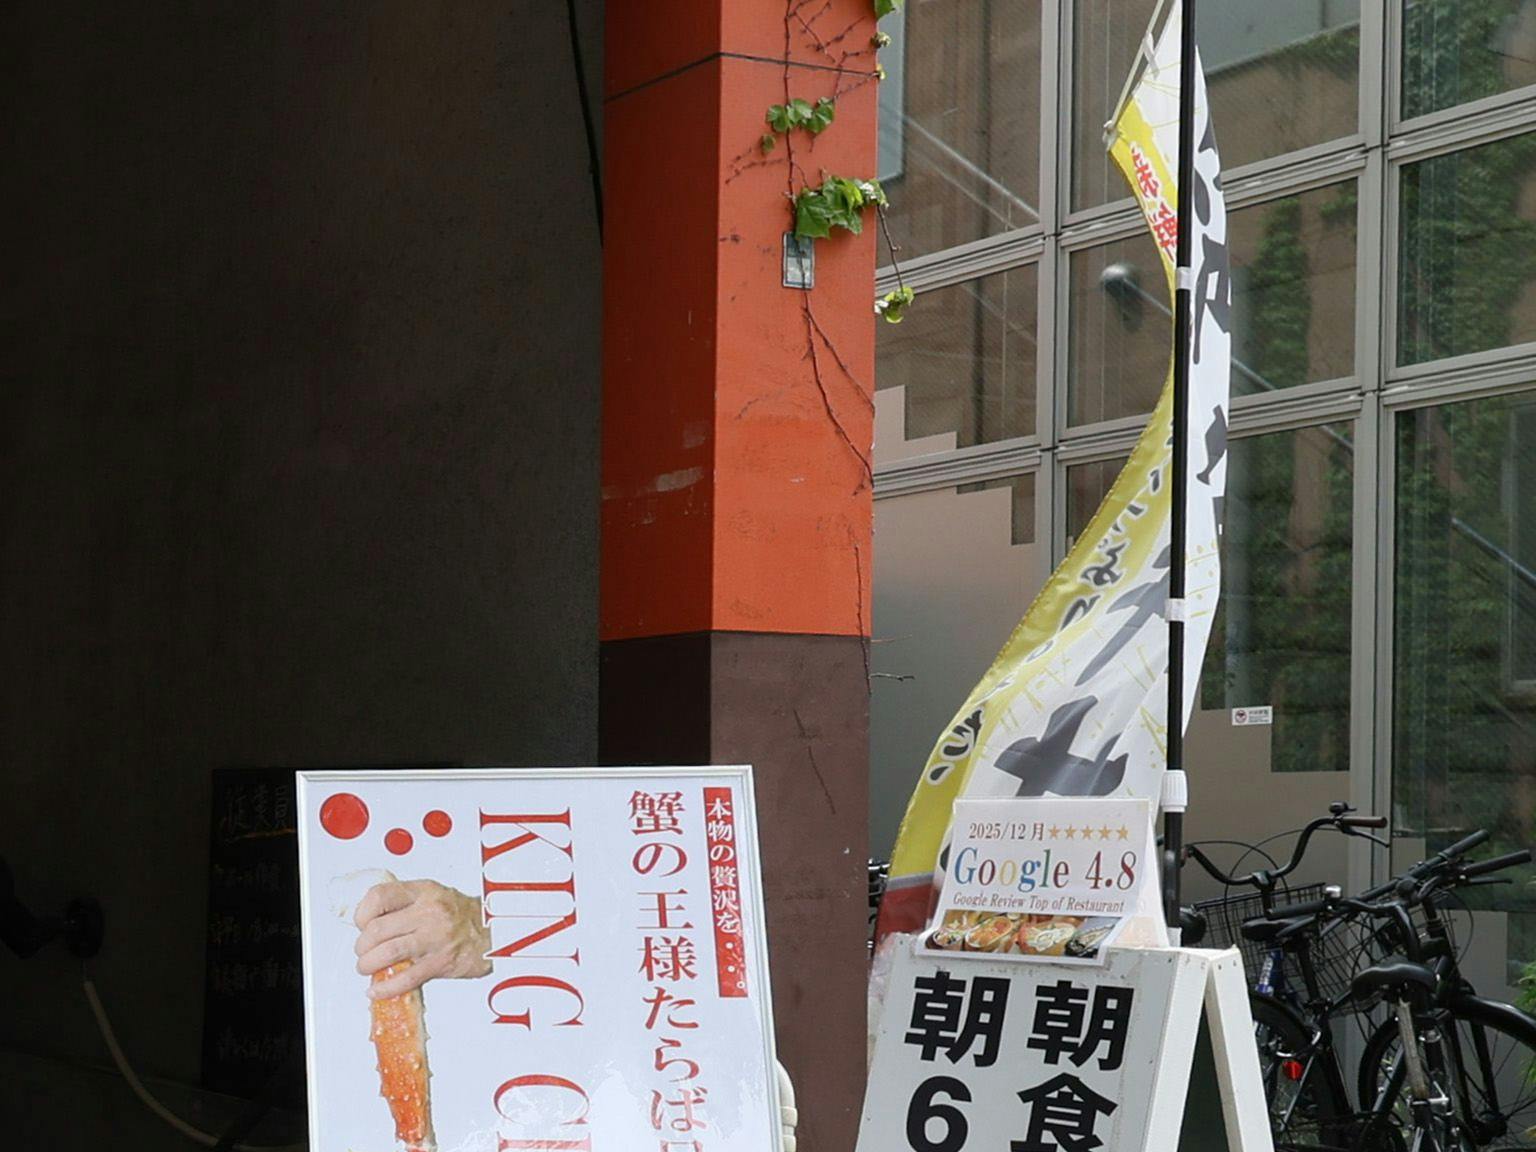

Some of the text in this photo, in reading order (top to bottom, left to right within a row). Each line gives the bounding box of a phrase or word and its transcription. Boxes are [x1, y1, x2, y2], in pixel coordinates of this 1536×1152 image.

[954, 846, 1137, 893] Google 4.8
[478, 806, 585, 1033] KING
[953, 891, 1125, 913] Google Review Top of Restaurant
